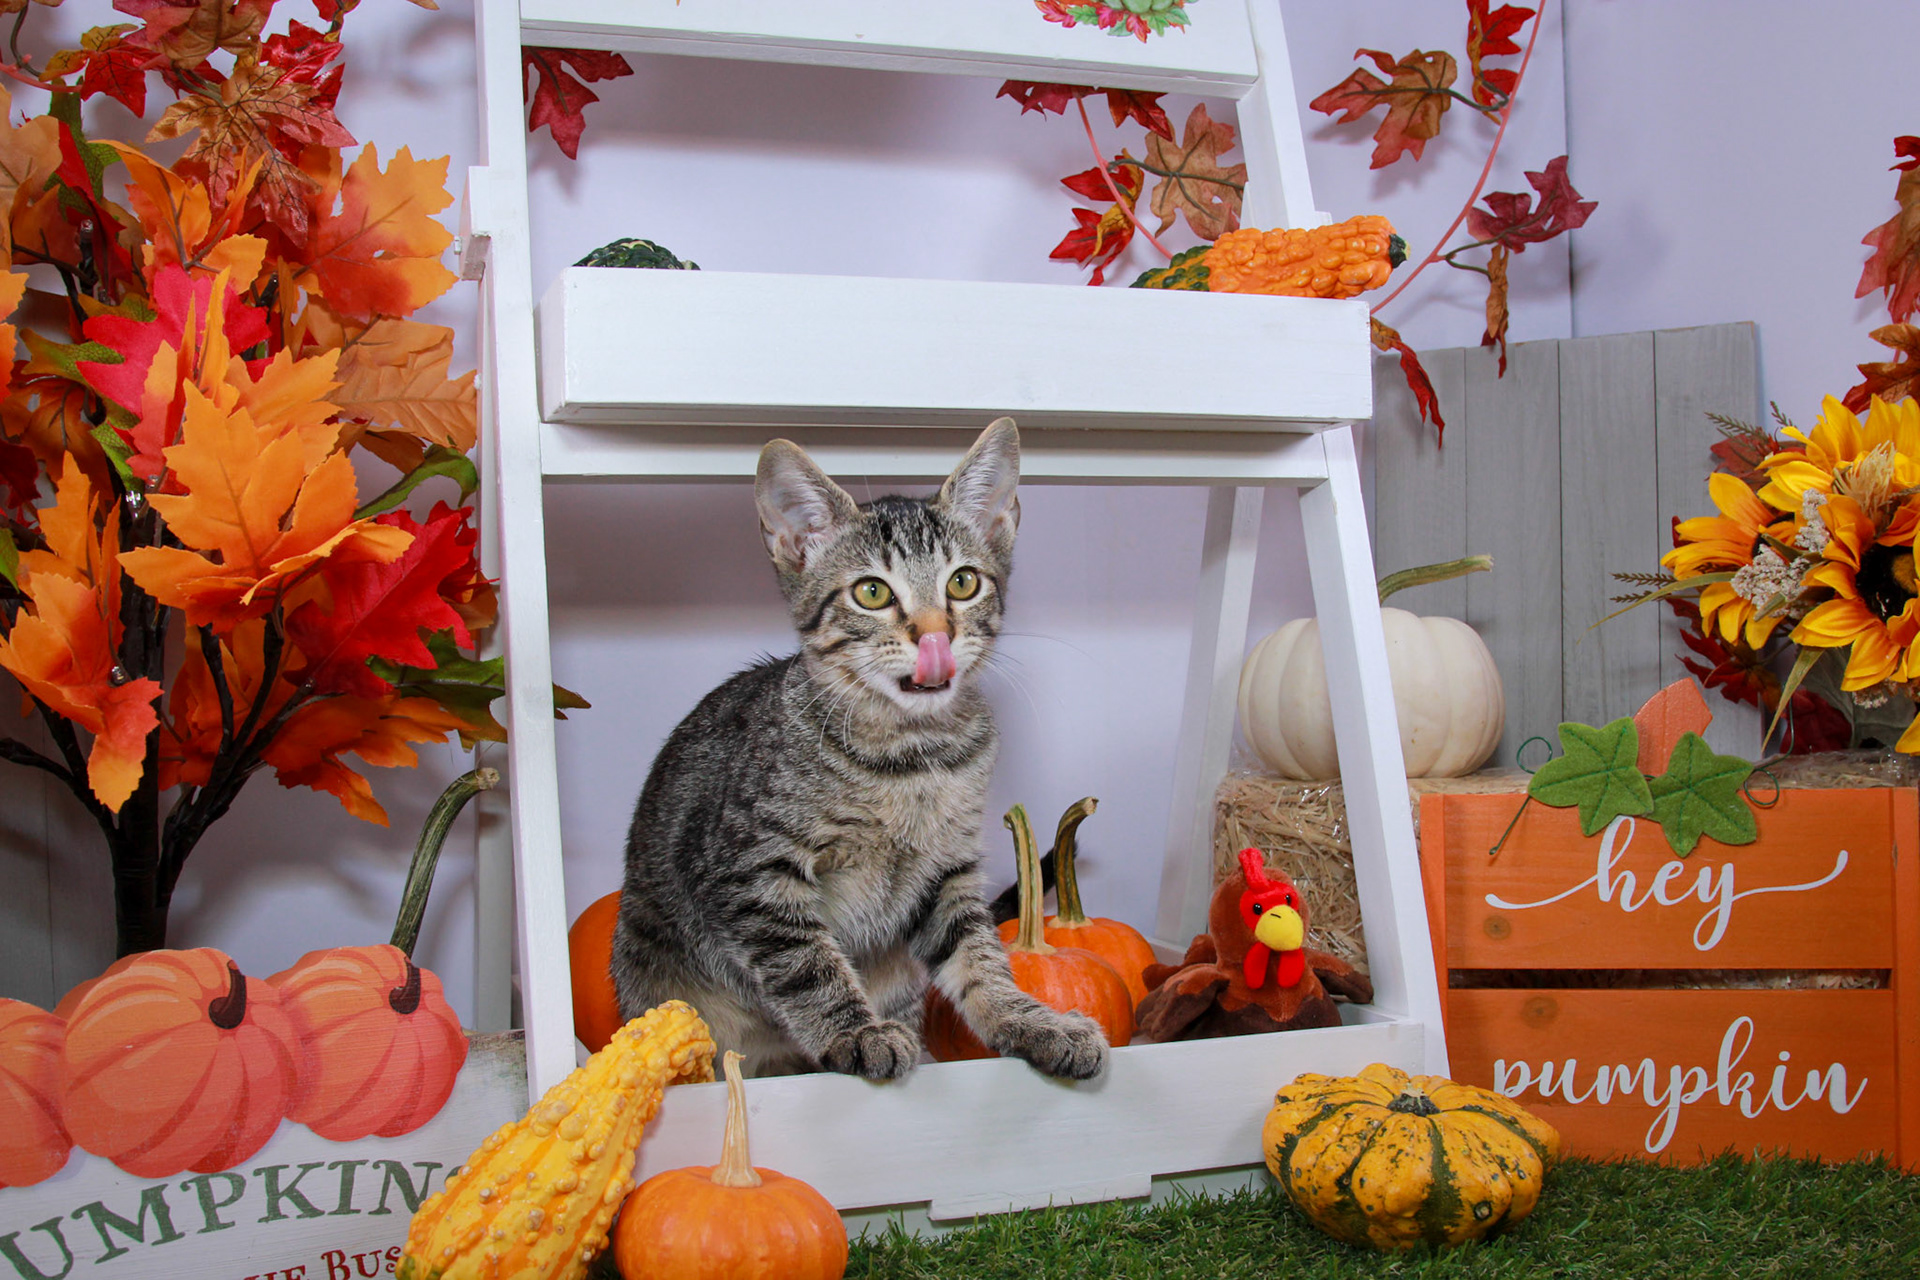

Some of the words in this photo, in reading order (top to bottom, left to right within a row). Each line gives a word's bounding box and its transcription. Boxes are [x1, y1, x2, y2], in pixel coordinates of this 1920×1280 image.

[1485, 815, 1849, 951] hey
[1494, 1016, 1868, 1154] pumpkin
[0, 1159, 463, 1280] UMPKIN
